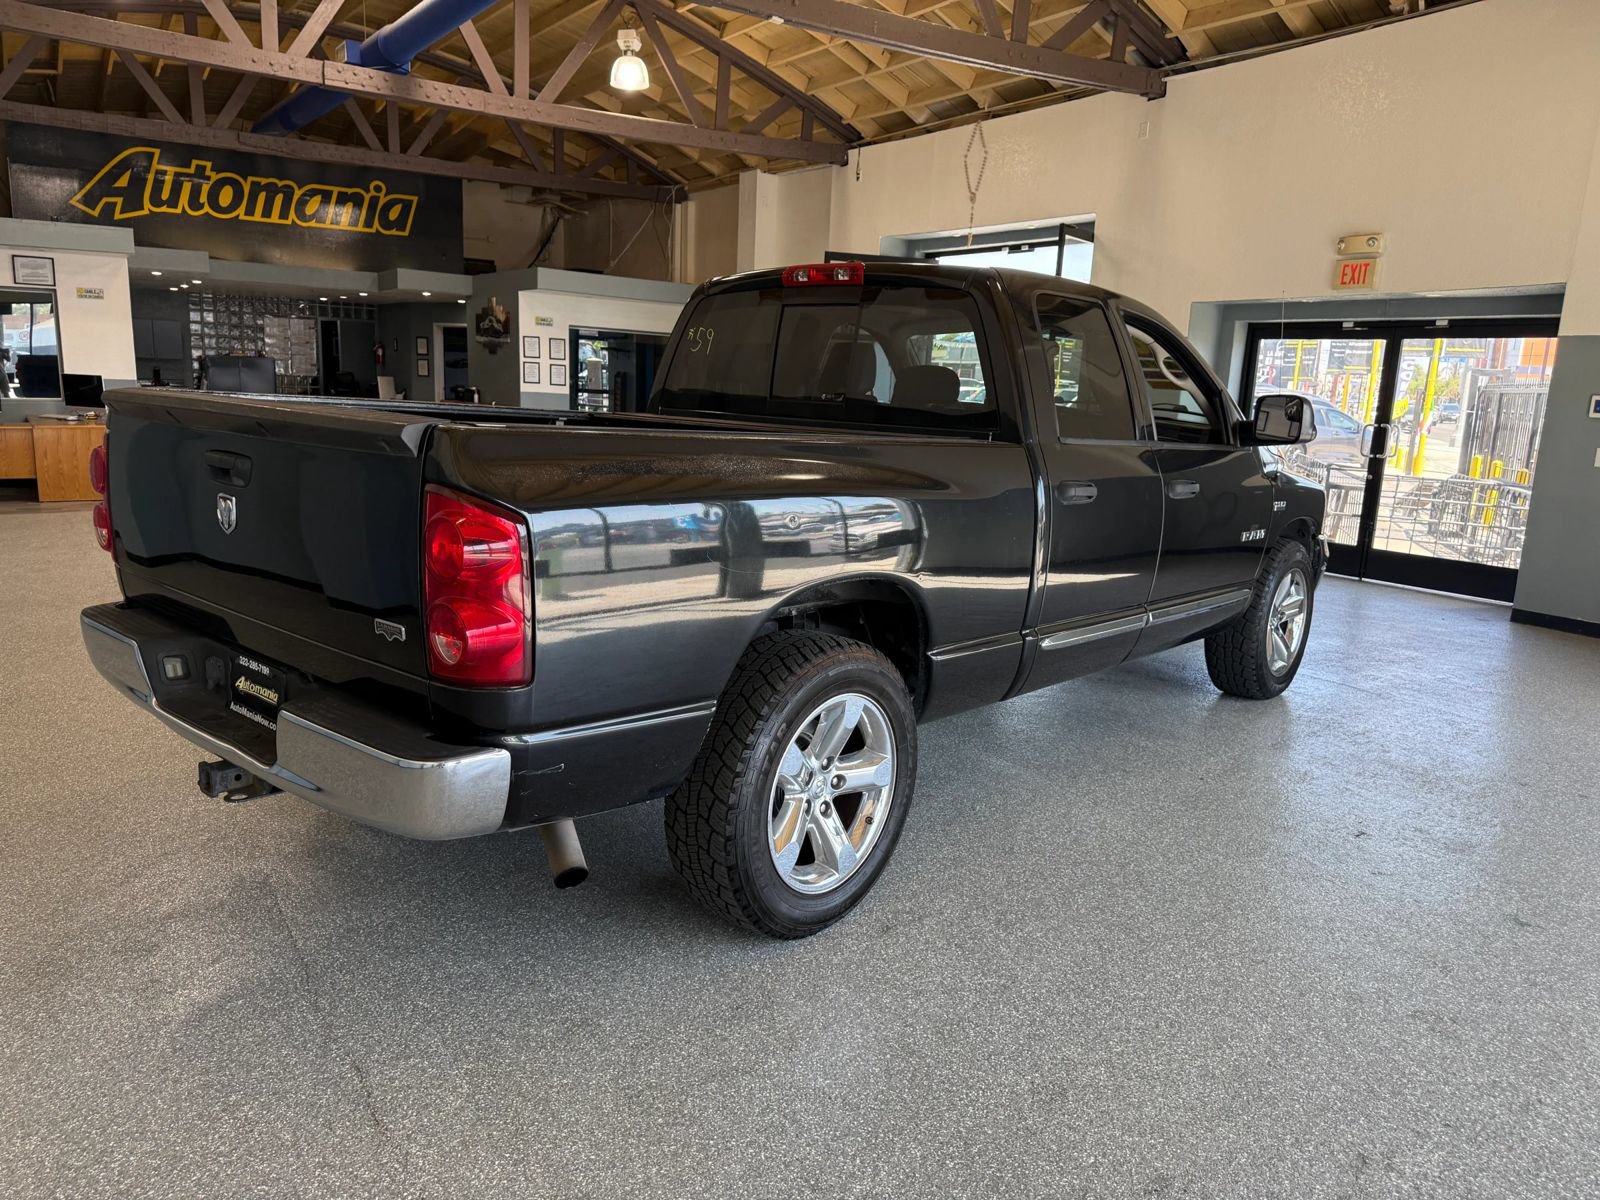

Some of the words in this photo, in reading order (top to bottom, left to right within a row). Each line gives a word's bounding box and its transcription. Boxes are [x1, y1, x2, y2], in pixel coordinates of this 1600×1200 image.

[69, 147, 418, 236] Automania
[1340, 263, 1370, 285] EXIT
[235, 675, 279, 702] Automania
[229, 701, 277, 731] AutoManiaNow.co
